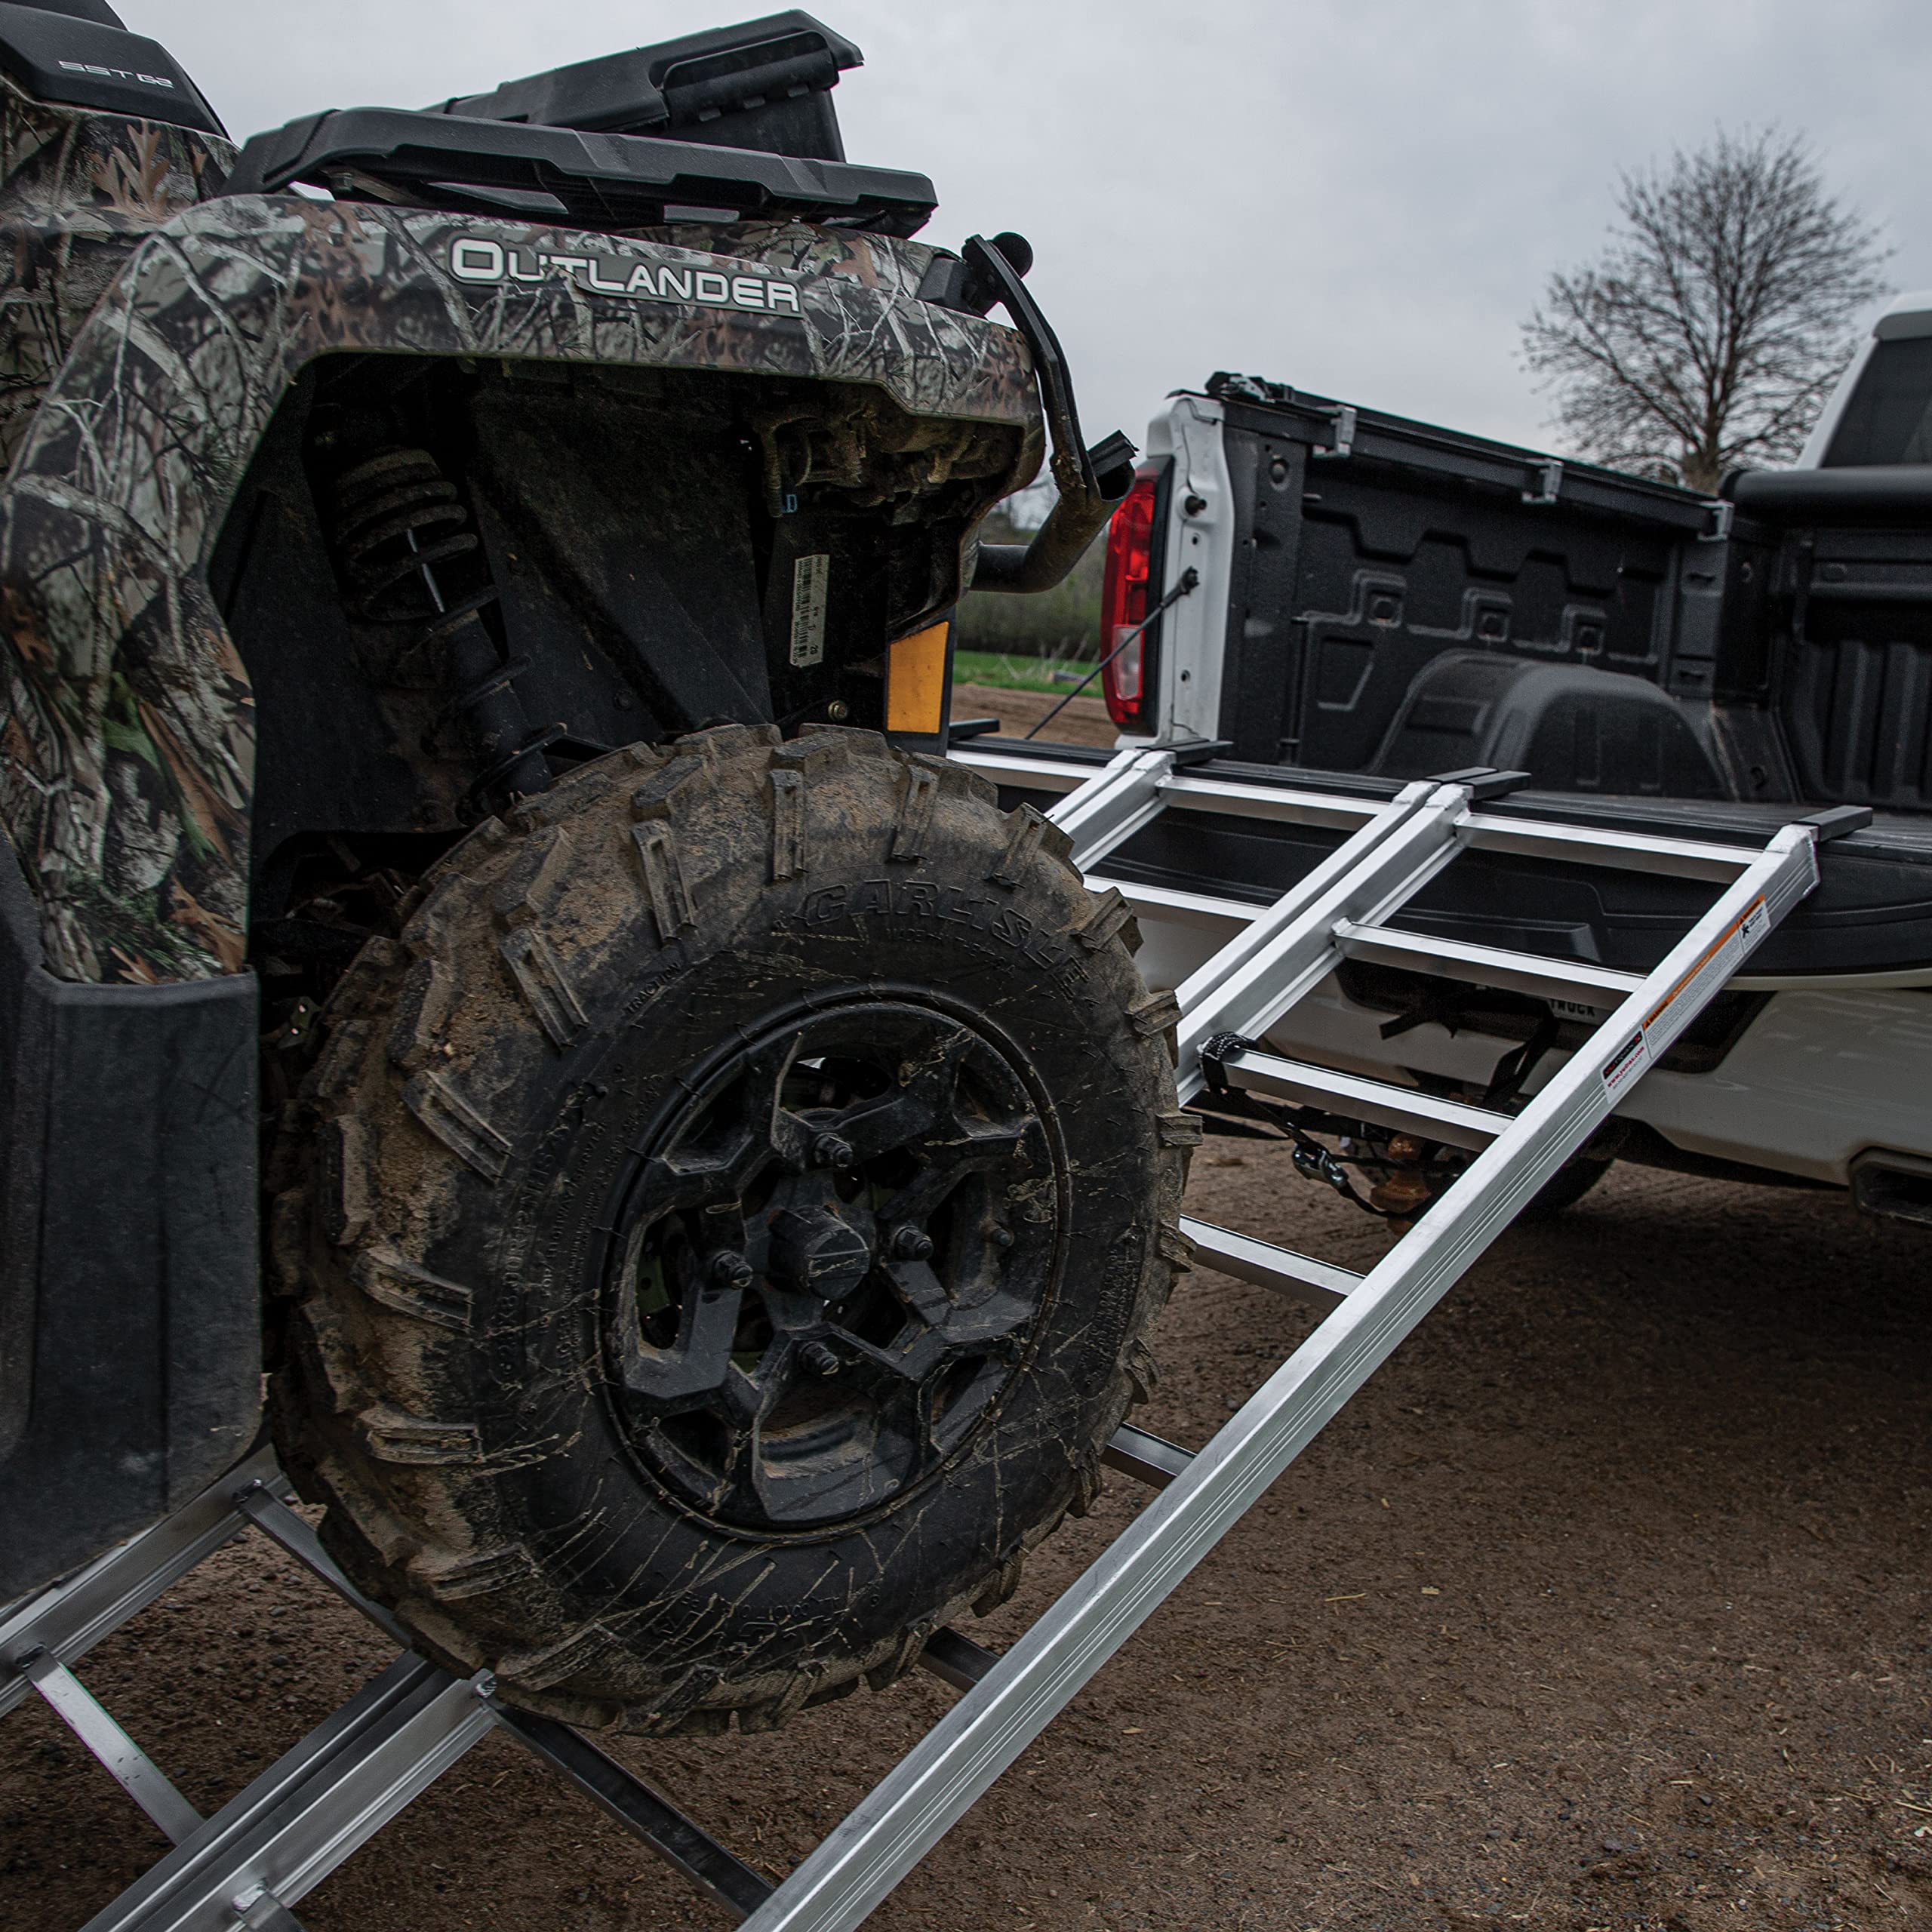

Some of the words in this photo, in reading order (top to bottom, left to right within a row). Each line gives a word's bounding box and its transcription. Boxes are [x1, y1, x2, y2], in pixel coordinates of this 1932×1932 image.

[58, 60, 134, 79] SST
[136, 73, 175, 89] G2
[452, 238, 801, 312] OUTLANDER
